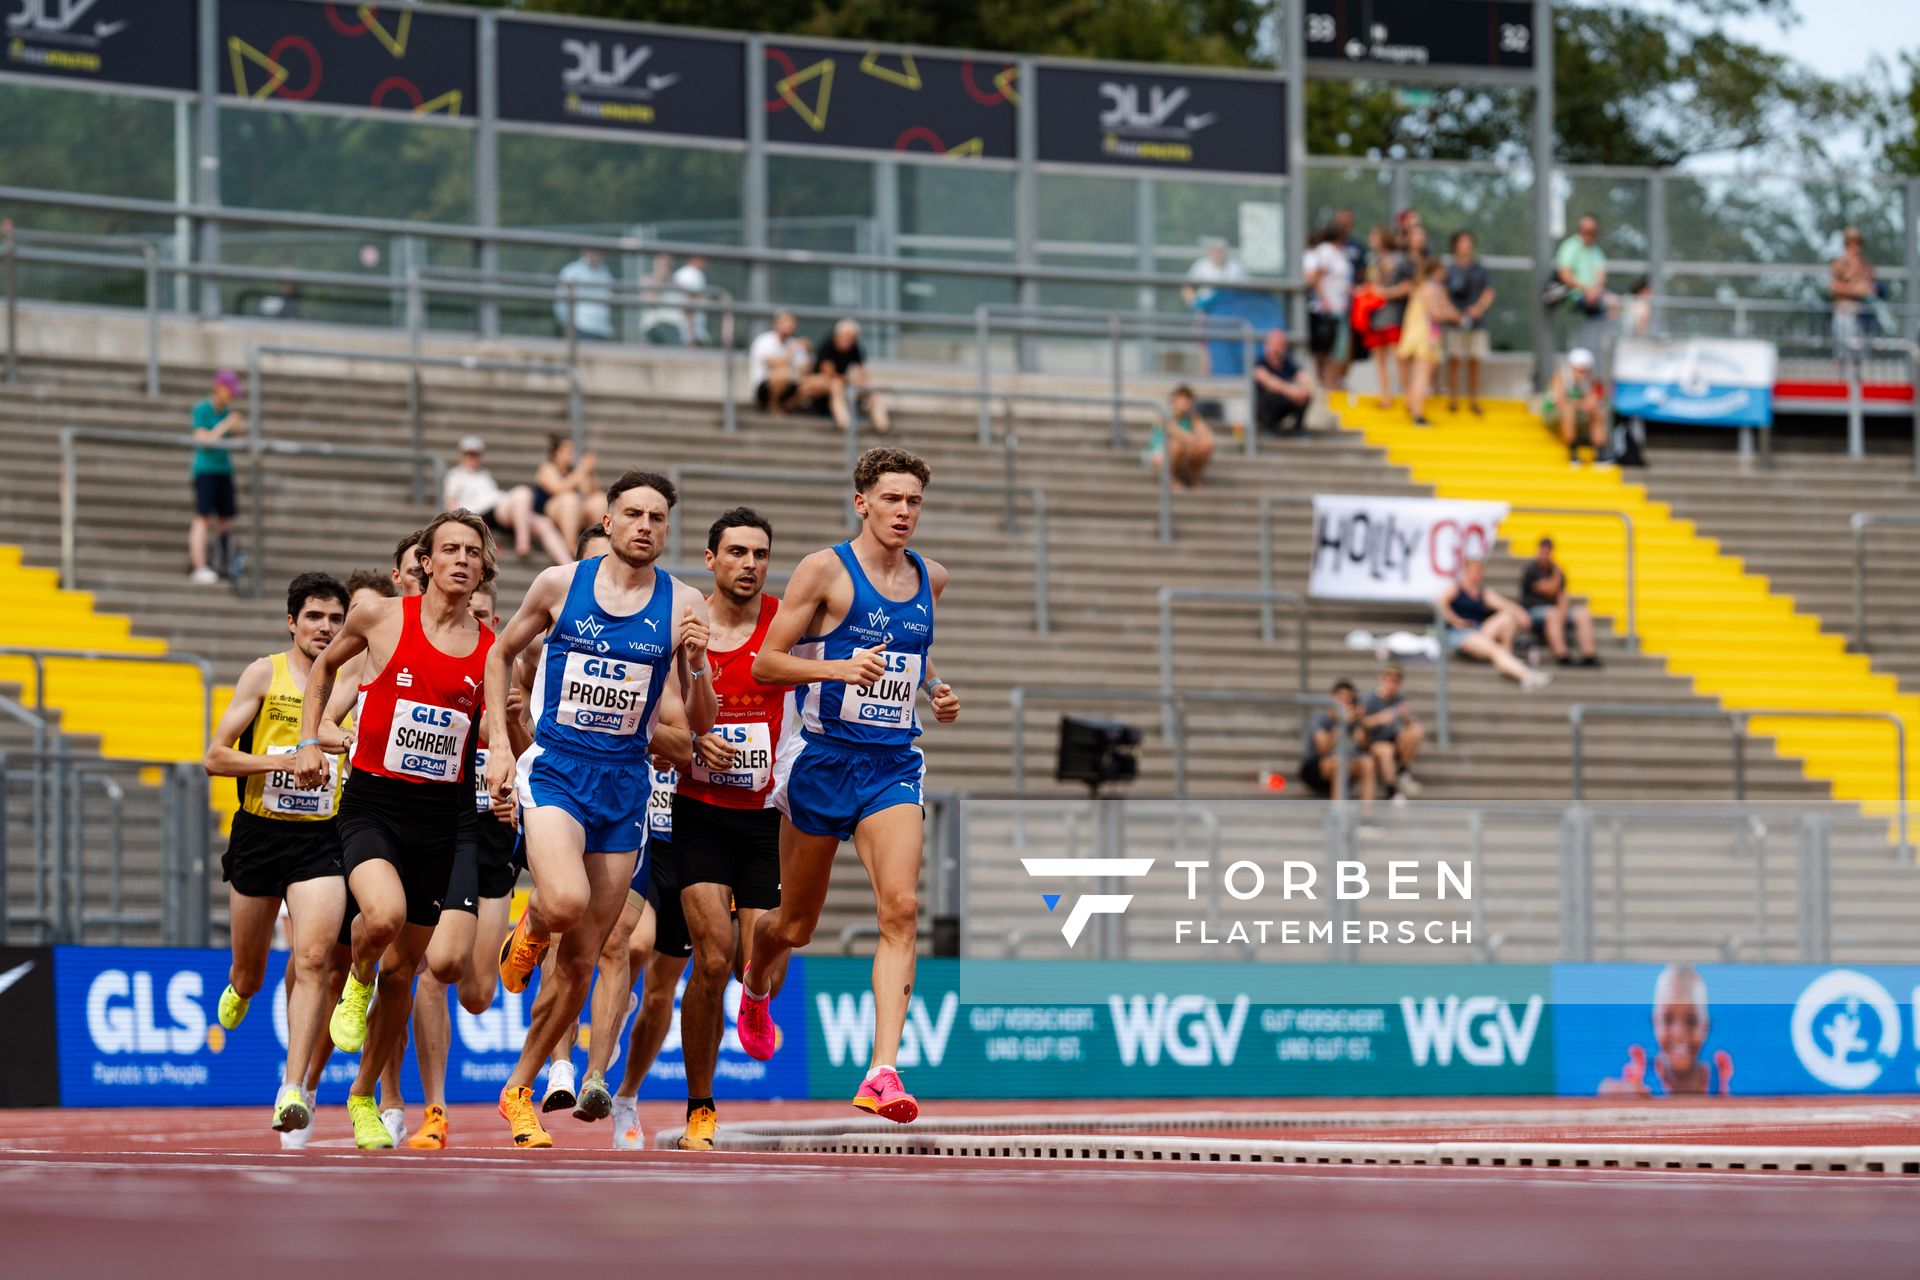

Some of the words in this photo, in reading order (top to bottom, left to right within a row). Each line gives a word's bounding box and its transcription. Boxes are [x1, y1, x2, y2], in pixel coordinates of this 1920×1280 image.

[1313, 511, 1423, 583] HOLLY
[849, 625, 882, 637] STADTWERKE
[903, 621, 929, 633] VIACTIV
[560, 634, 594, 646] STADTWERKE
[861, 635, 882, 643] BOCHUM
[570, 642, 594, 652] BOCHUM
[628, 641, 664, 654] VIACTIV
[569, 681, 640, 711] PROBST
[269, 713, 298, 724] infinex
[879, 708, 901, 718] PLAN
[594, 715, 621, 725] PLAN
[396, 727, 457, 756] SCHREML
[421, 760, 445, 770] PLAN
[726, 776, 751, 784] PLAN
[295, 798, 318, 806] PLAN
[1109, 993, 1250, 1067] WGV
[1400, 995, 1542, 1066] WGV
